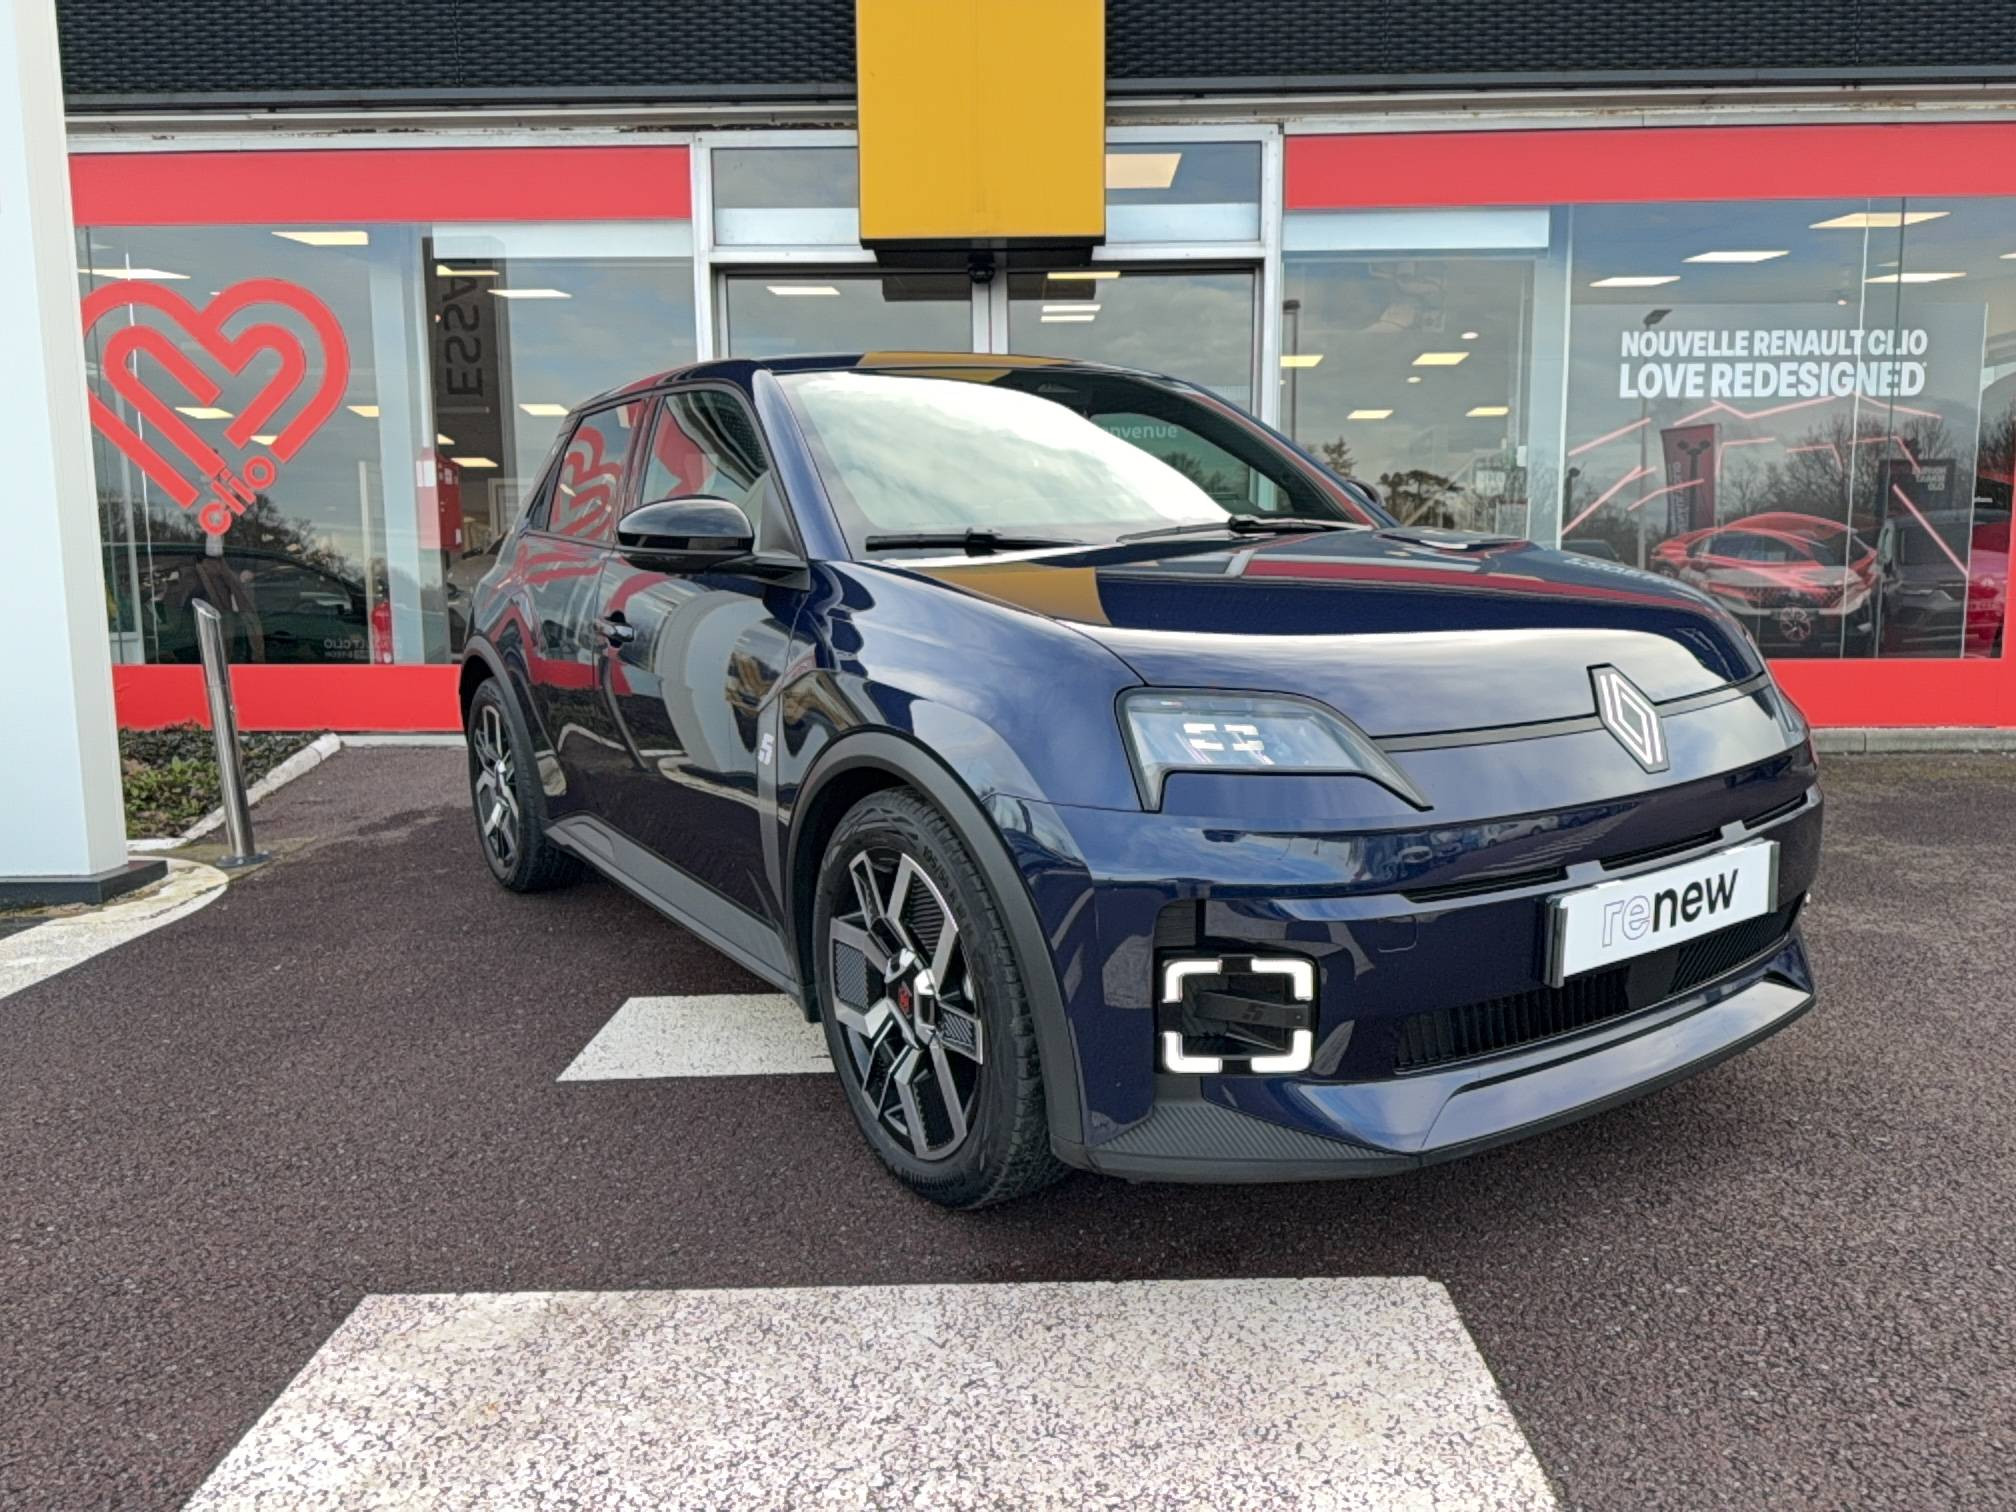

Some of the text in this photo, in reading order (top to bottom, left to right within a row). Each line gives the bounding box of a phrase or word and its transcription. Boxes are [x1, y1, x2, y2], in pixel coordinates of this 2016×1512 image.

[1621, 329, 1928, 357] NOUVELLE RENAULT CLIO
[1619, 360, 1926, 398] LOVE REDESIGNED
[1106, 425, 1178, 439] nvenue
[198, 454, 277, 536] clio
[1602, 868, 1740, 948] renew
